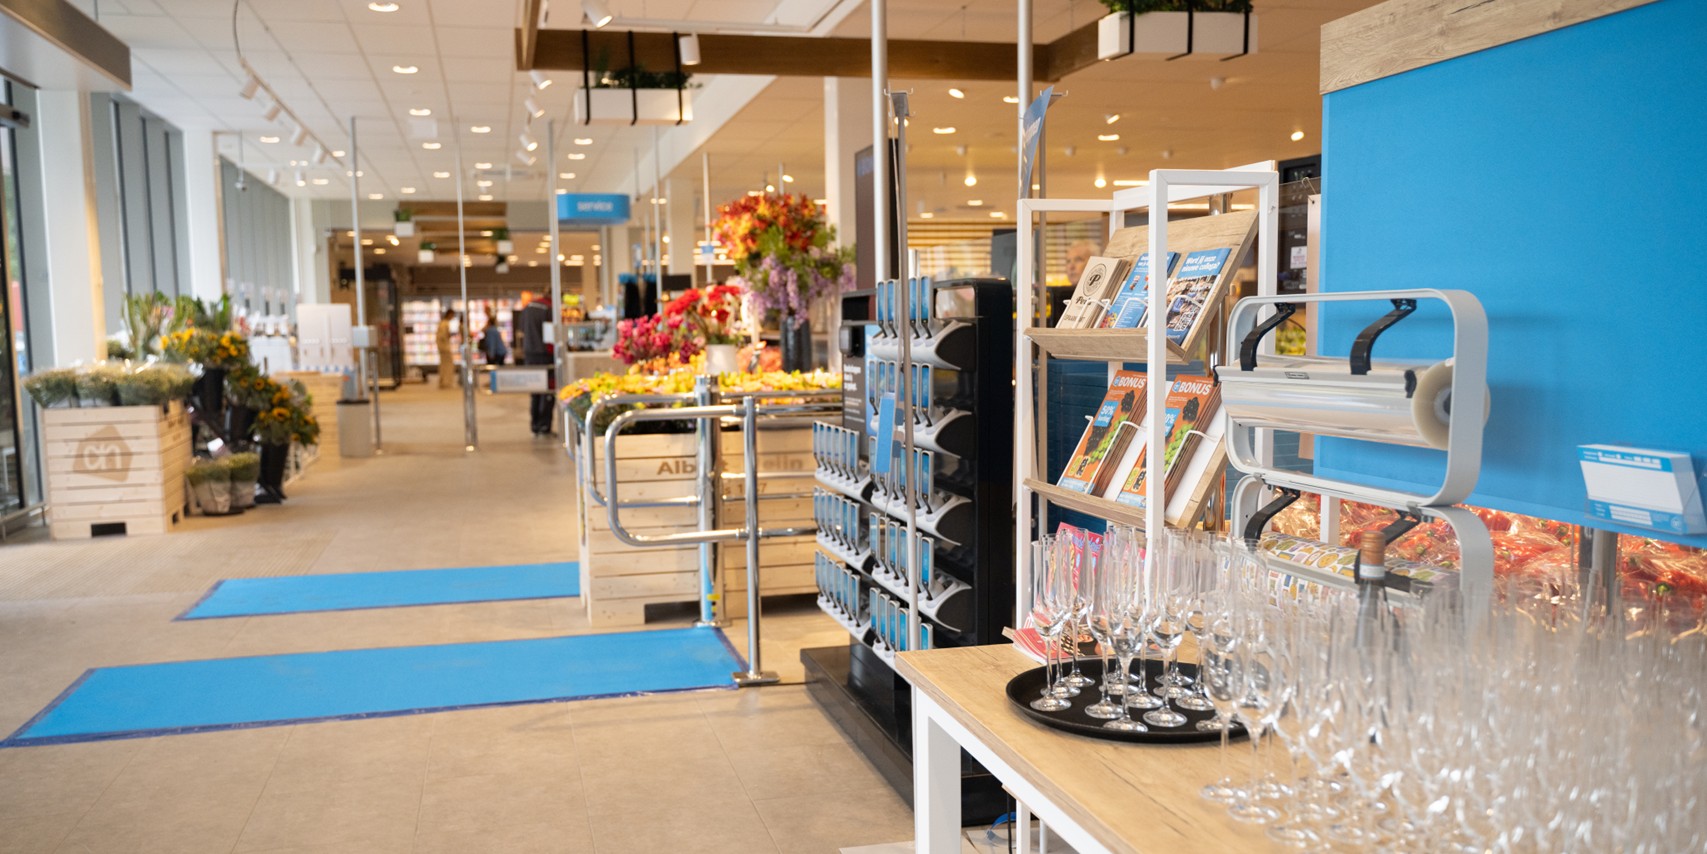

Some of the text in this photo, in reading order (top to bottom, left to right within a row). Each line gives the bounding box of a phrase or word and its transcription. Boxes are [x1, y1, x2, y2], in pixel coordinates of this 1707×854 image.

[577, 201, 615, 213] service
[1118, 376, 1146, 389] BONUS
[1179, 381, 1212, 395] BONUS
